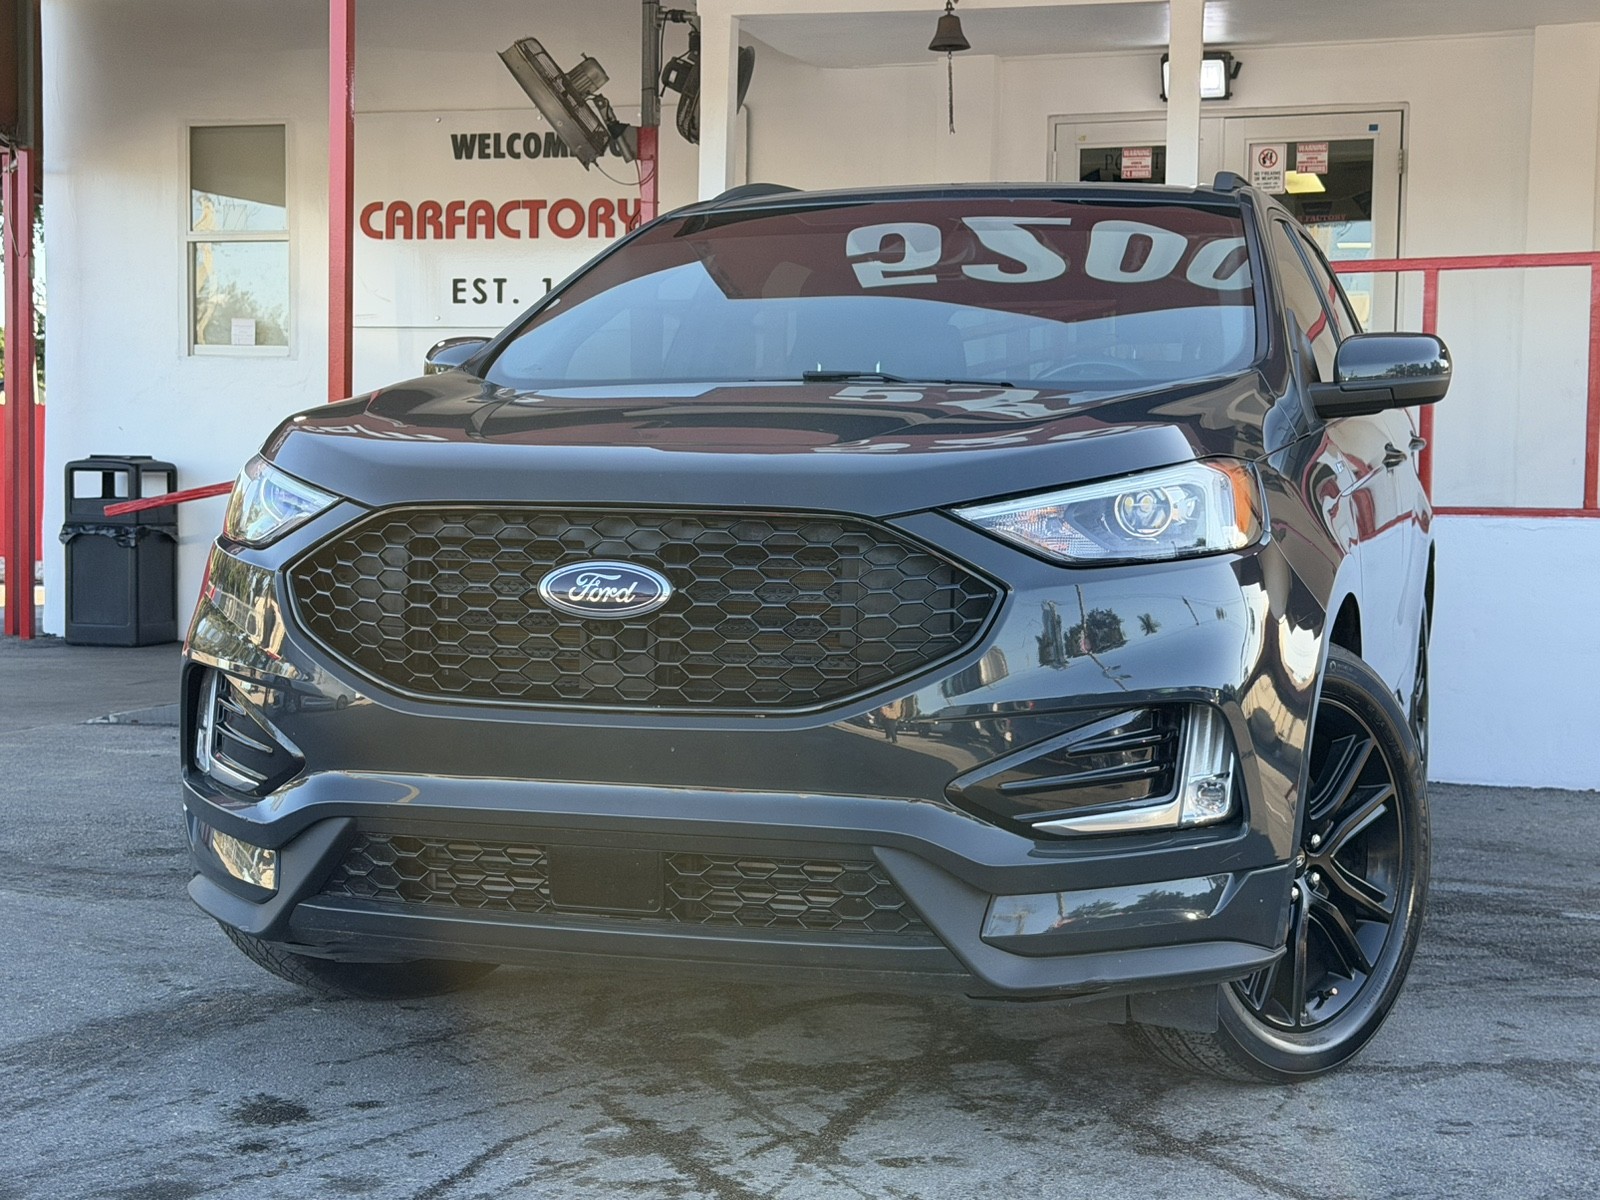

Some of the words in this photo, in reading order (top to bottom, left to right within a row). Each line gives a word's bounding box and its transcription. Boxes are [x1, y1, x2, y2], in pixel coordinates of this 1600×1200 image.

[451, 131, 577, 160] WELCOM
[360, 198, 642, 240] CARFACTORY
[452, 277, 520, 305] EST.
[568, 572, 639, 604] Ford
